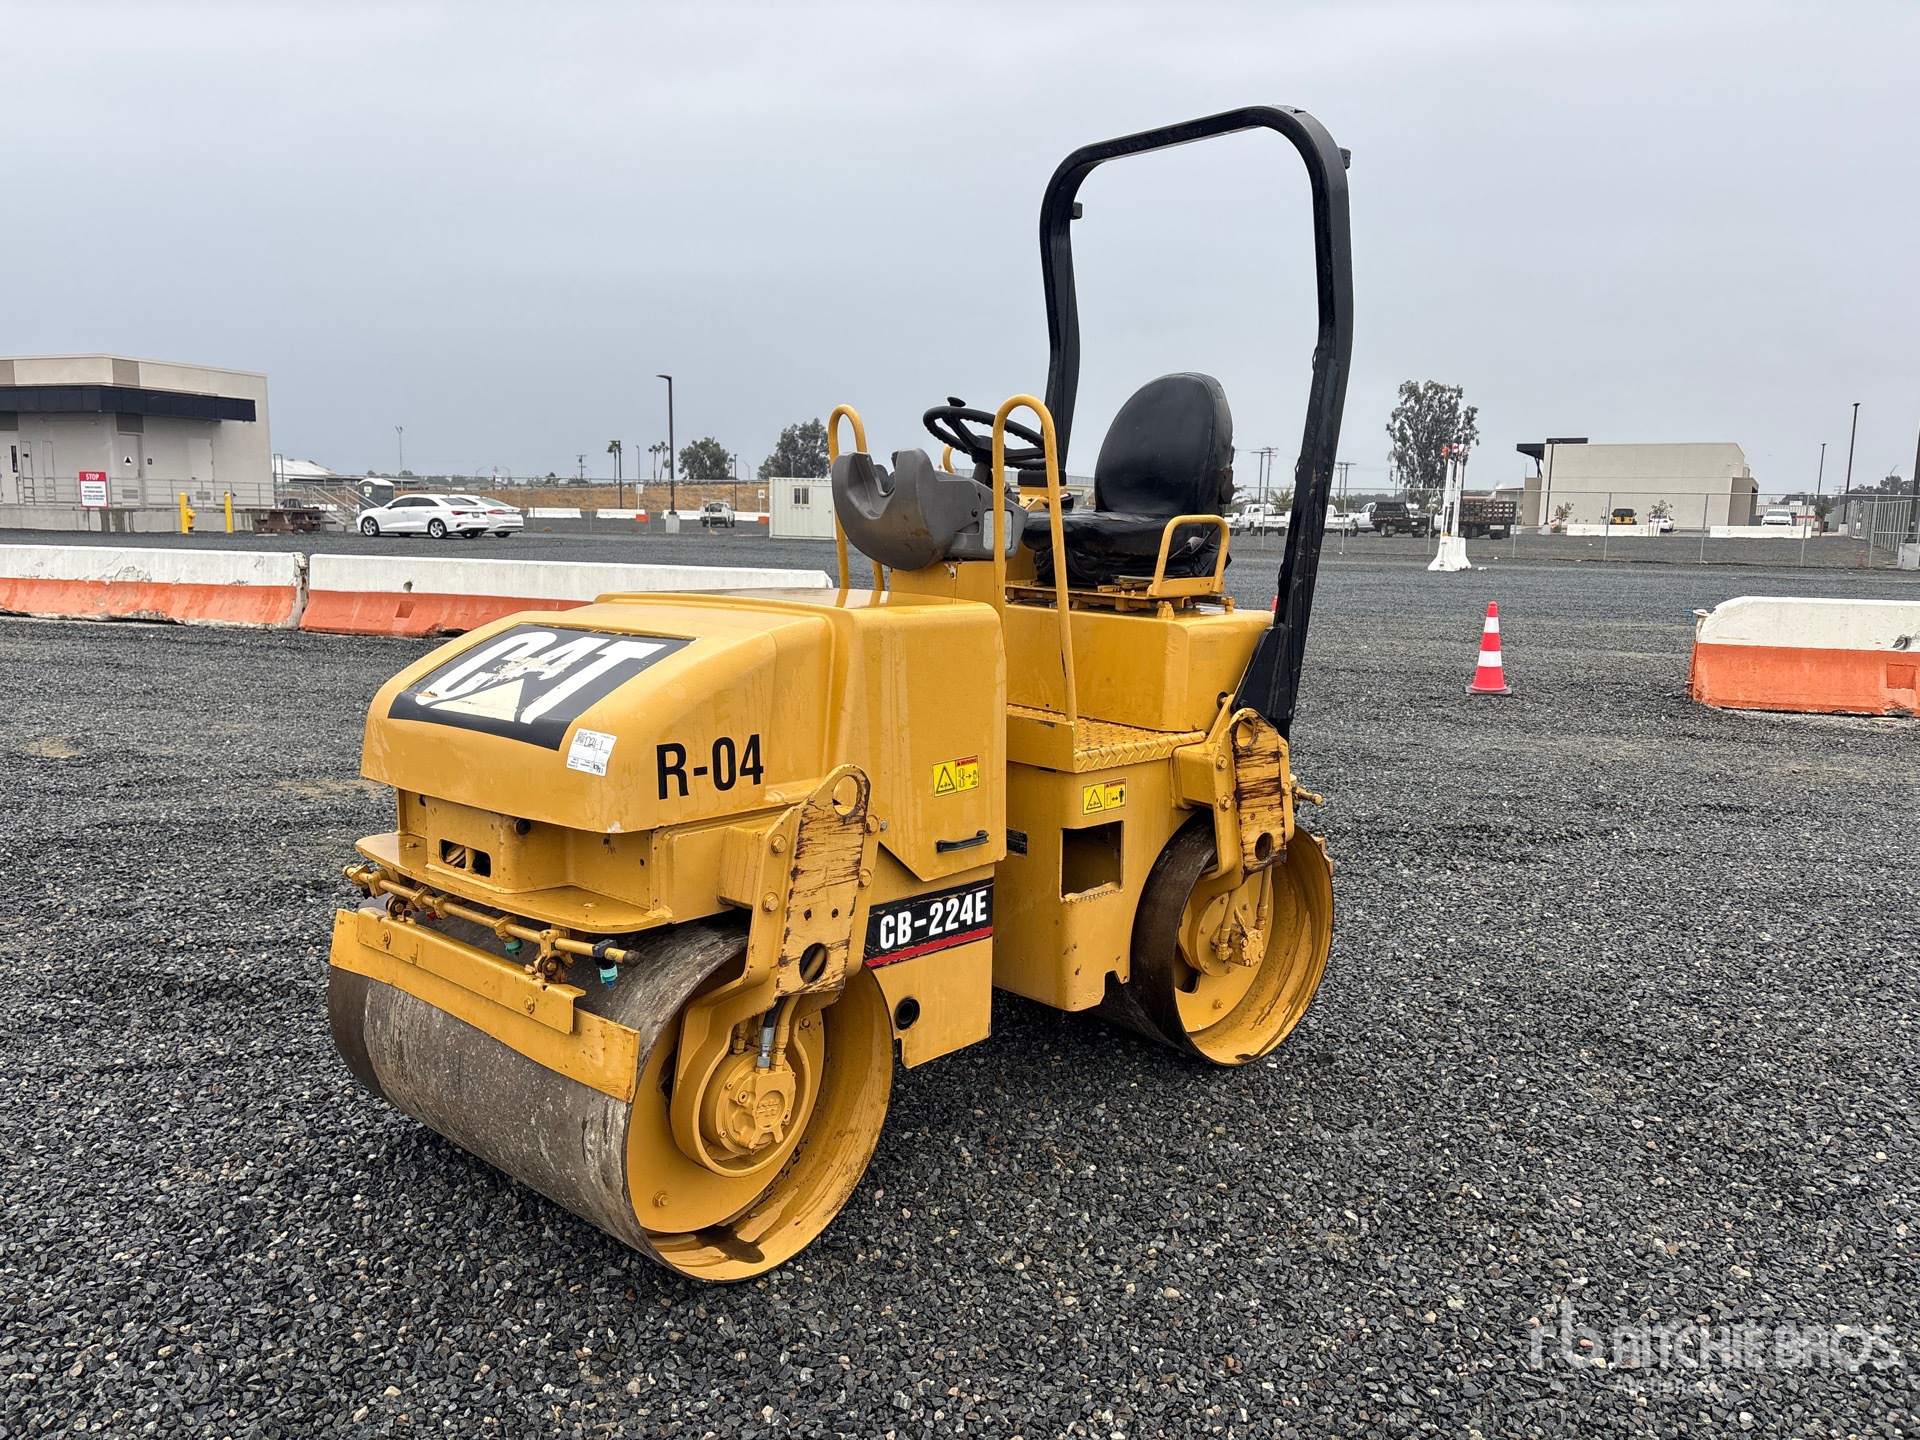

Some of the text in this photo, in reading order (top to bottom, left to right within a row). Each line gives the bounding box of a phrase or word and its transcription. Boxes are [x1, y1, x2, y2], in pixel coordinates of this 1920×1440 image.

[415, 631, 667, 724] CAT
[656, 733, 764, 800] R-04
[879, 890, 987, 950] CB-224E
